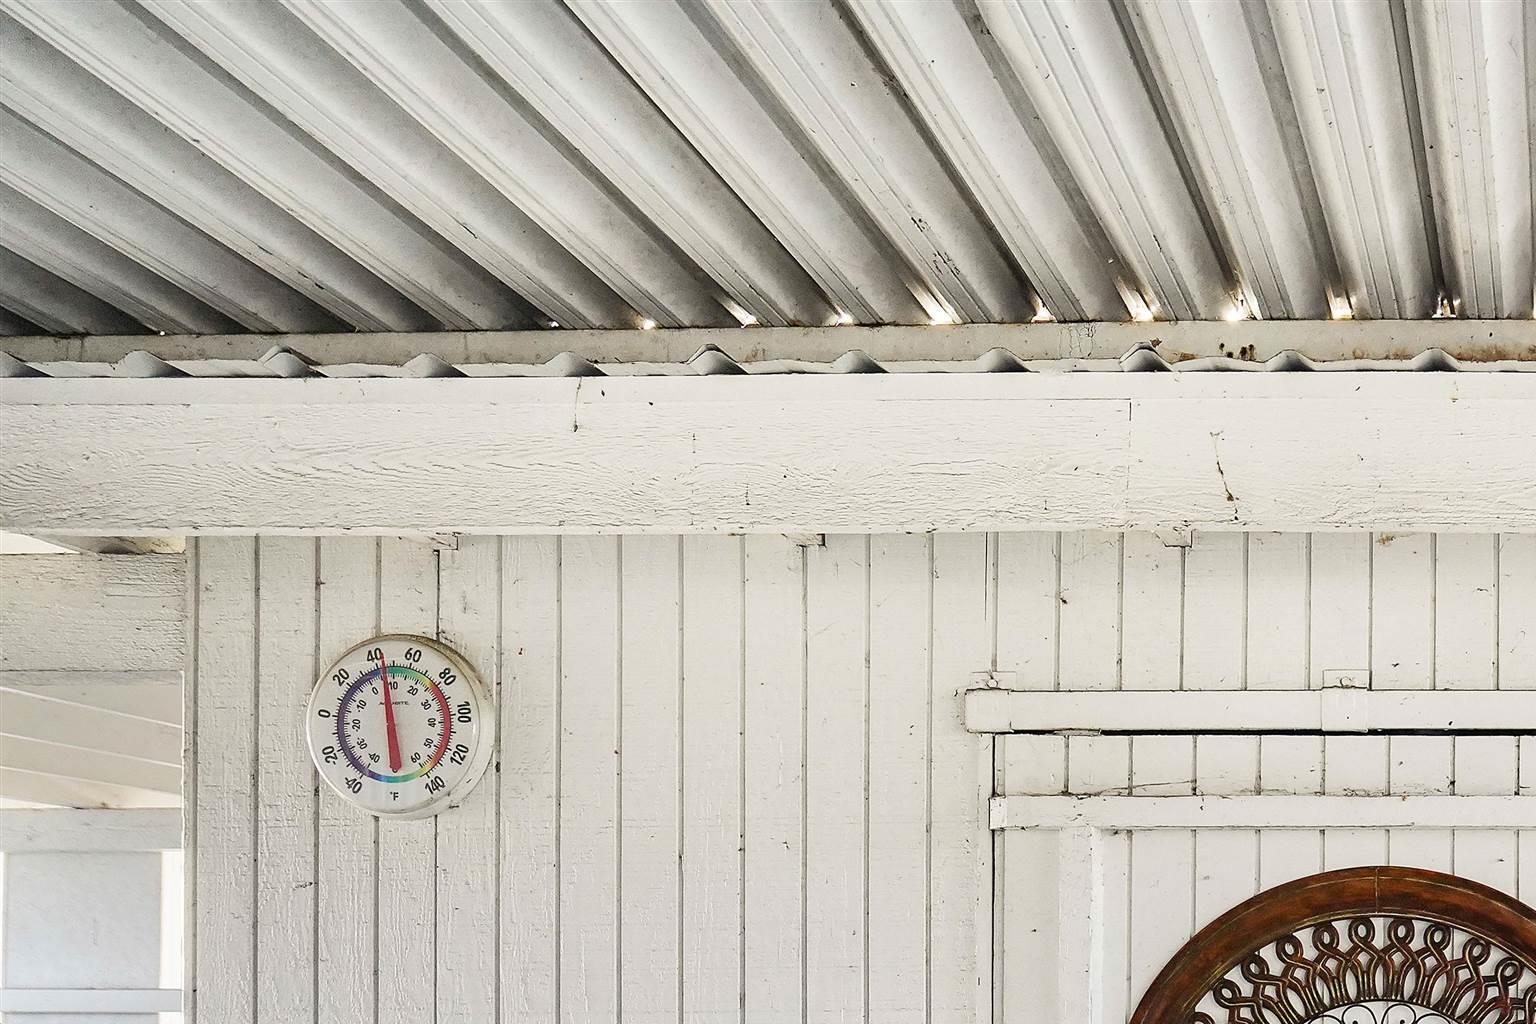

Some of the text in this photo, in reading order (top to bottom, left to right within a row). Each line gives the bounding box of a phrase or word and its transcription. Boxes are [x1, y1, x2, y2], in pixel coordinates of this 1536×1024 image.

[367, 647, 382, 662] 40
[405, 648, 421, 662] 60
[332, 668, 349, 686] 20
[438, 668, 456, 685] 80
[371, 686, 379, 695] 0
[389, 681, 398, 690] 10
[407, 685, 418, 696] 20
[357, 700, 367, 712] -10
[421, 699, 431, 710] 30
[318, 709, 331, 718] 0
[457, 701, 472, 723] 100
[352, 719, 361, 732] -20
[427, 718, 436, 728] 40
[357, 738, 367, 750] -30
[424, 738, 434, 748] 50
[322, 746, 338, 765] -20
[411, 752, 421, 763] 60
[450, 744, 469, 765] 120
[345, 777, 362, 794] -40
[425, 776, 445, 794] 140
